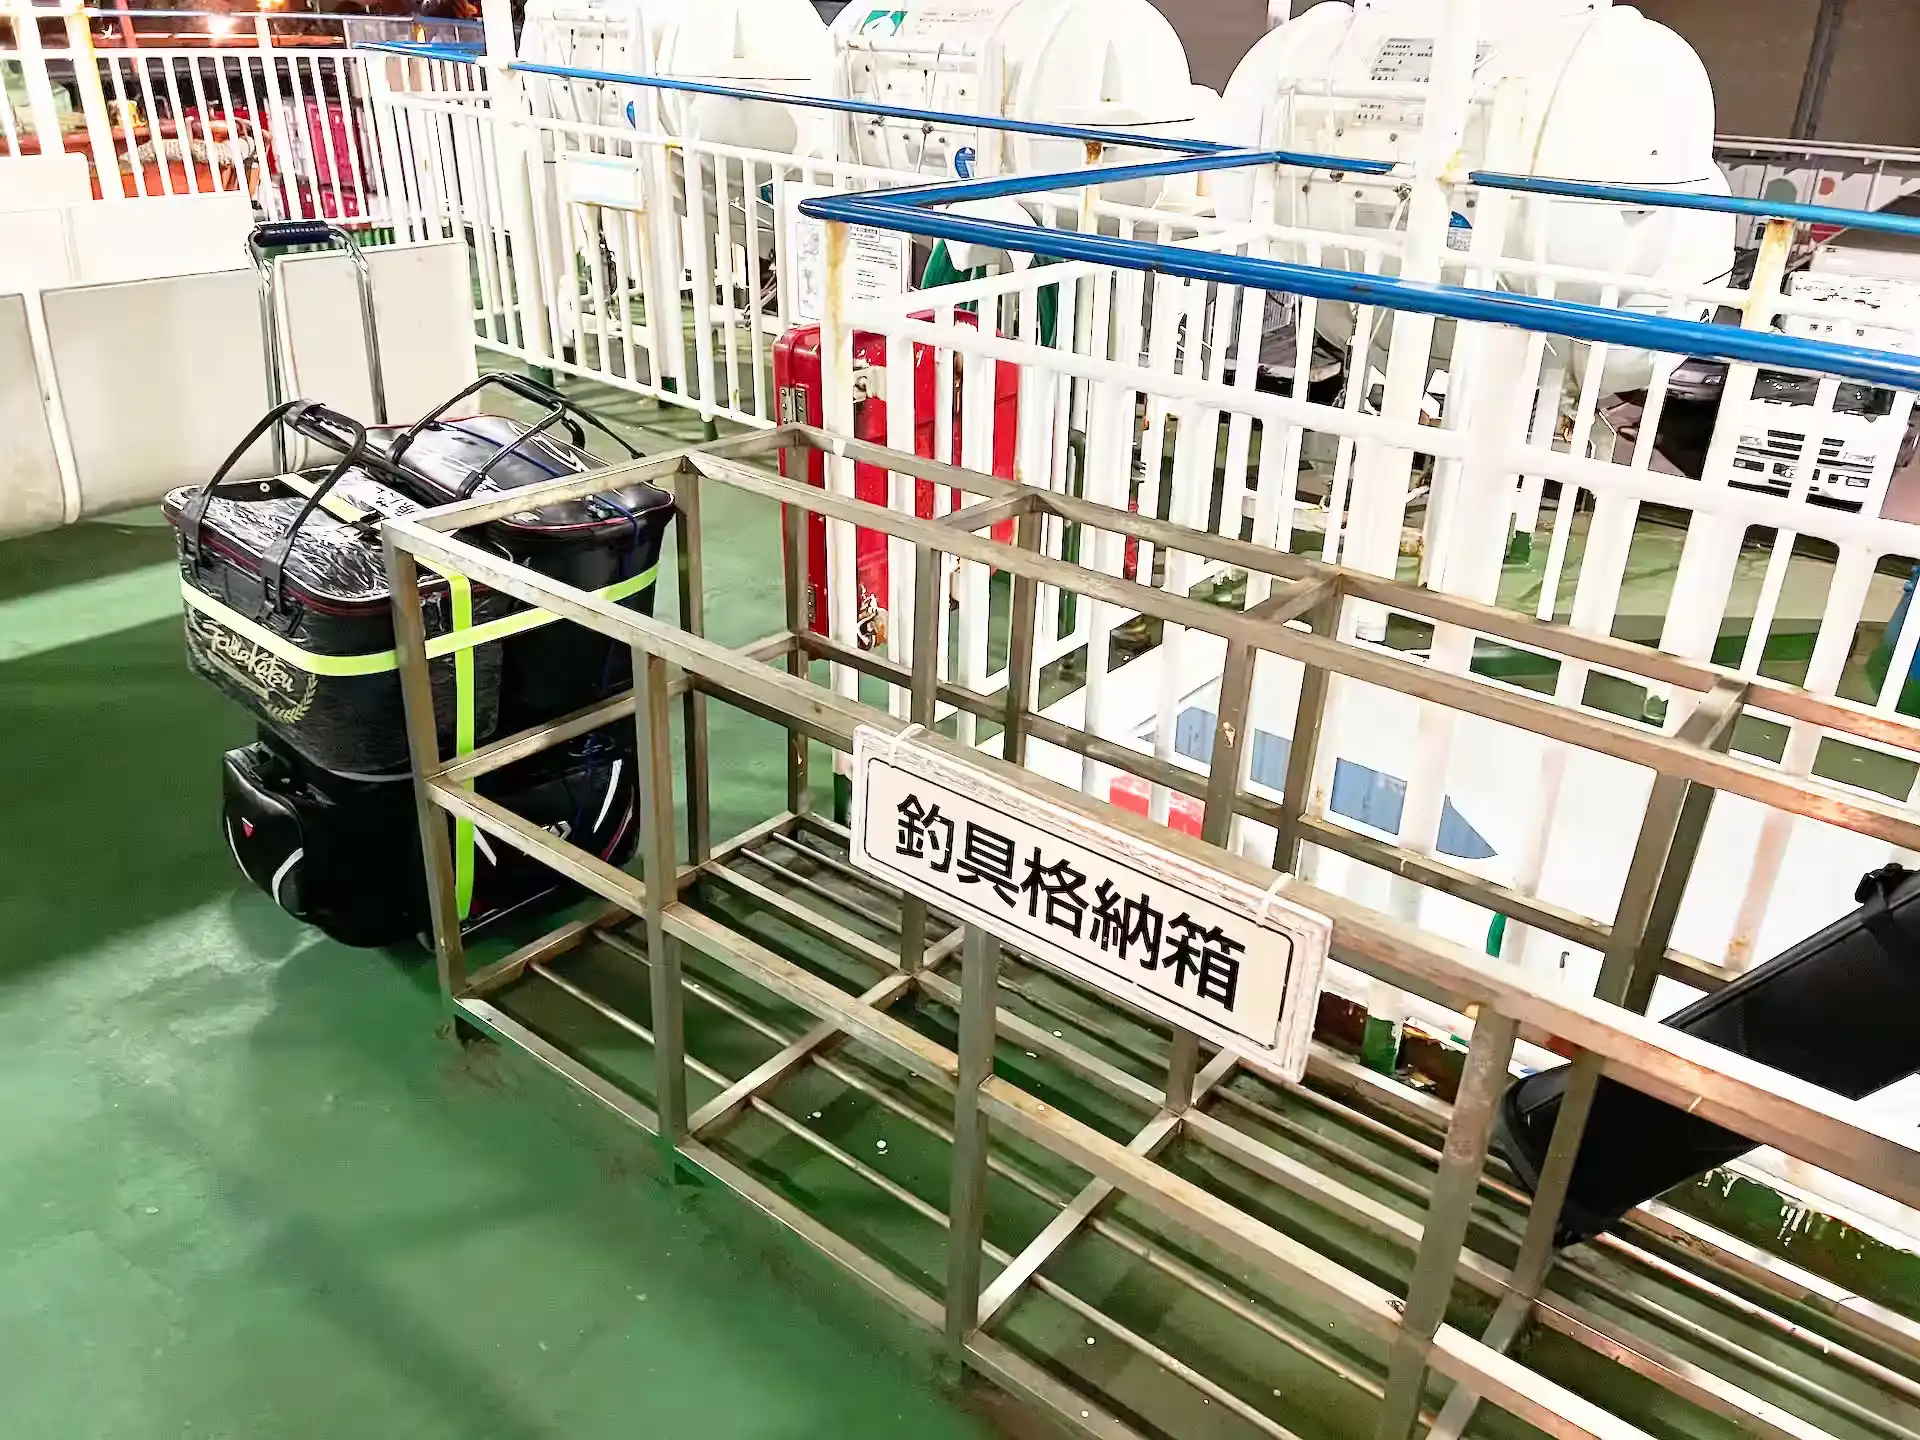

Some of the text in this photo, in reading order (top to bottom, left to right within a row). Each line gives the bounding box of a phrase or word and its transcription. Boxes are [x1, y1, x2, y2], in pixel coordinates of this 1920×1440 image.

[895, 793, 1246, 1013] 釣具格納箱
